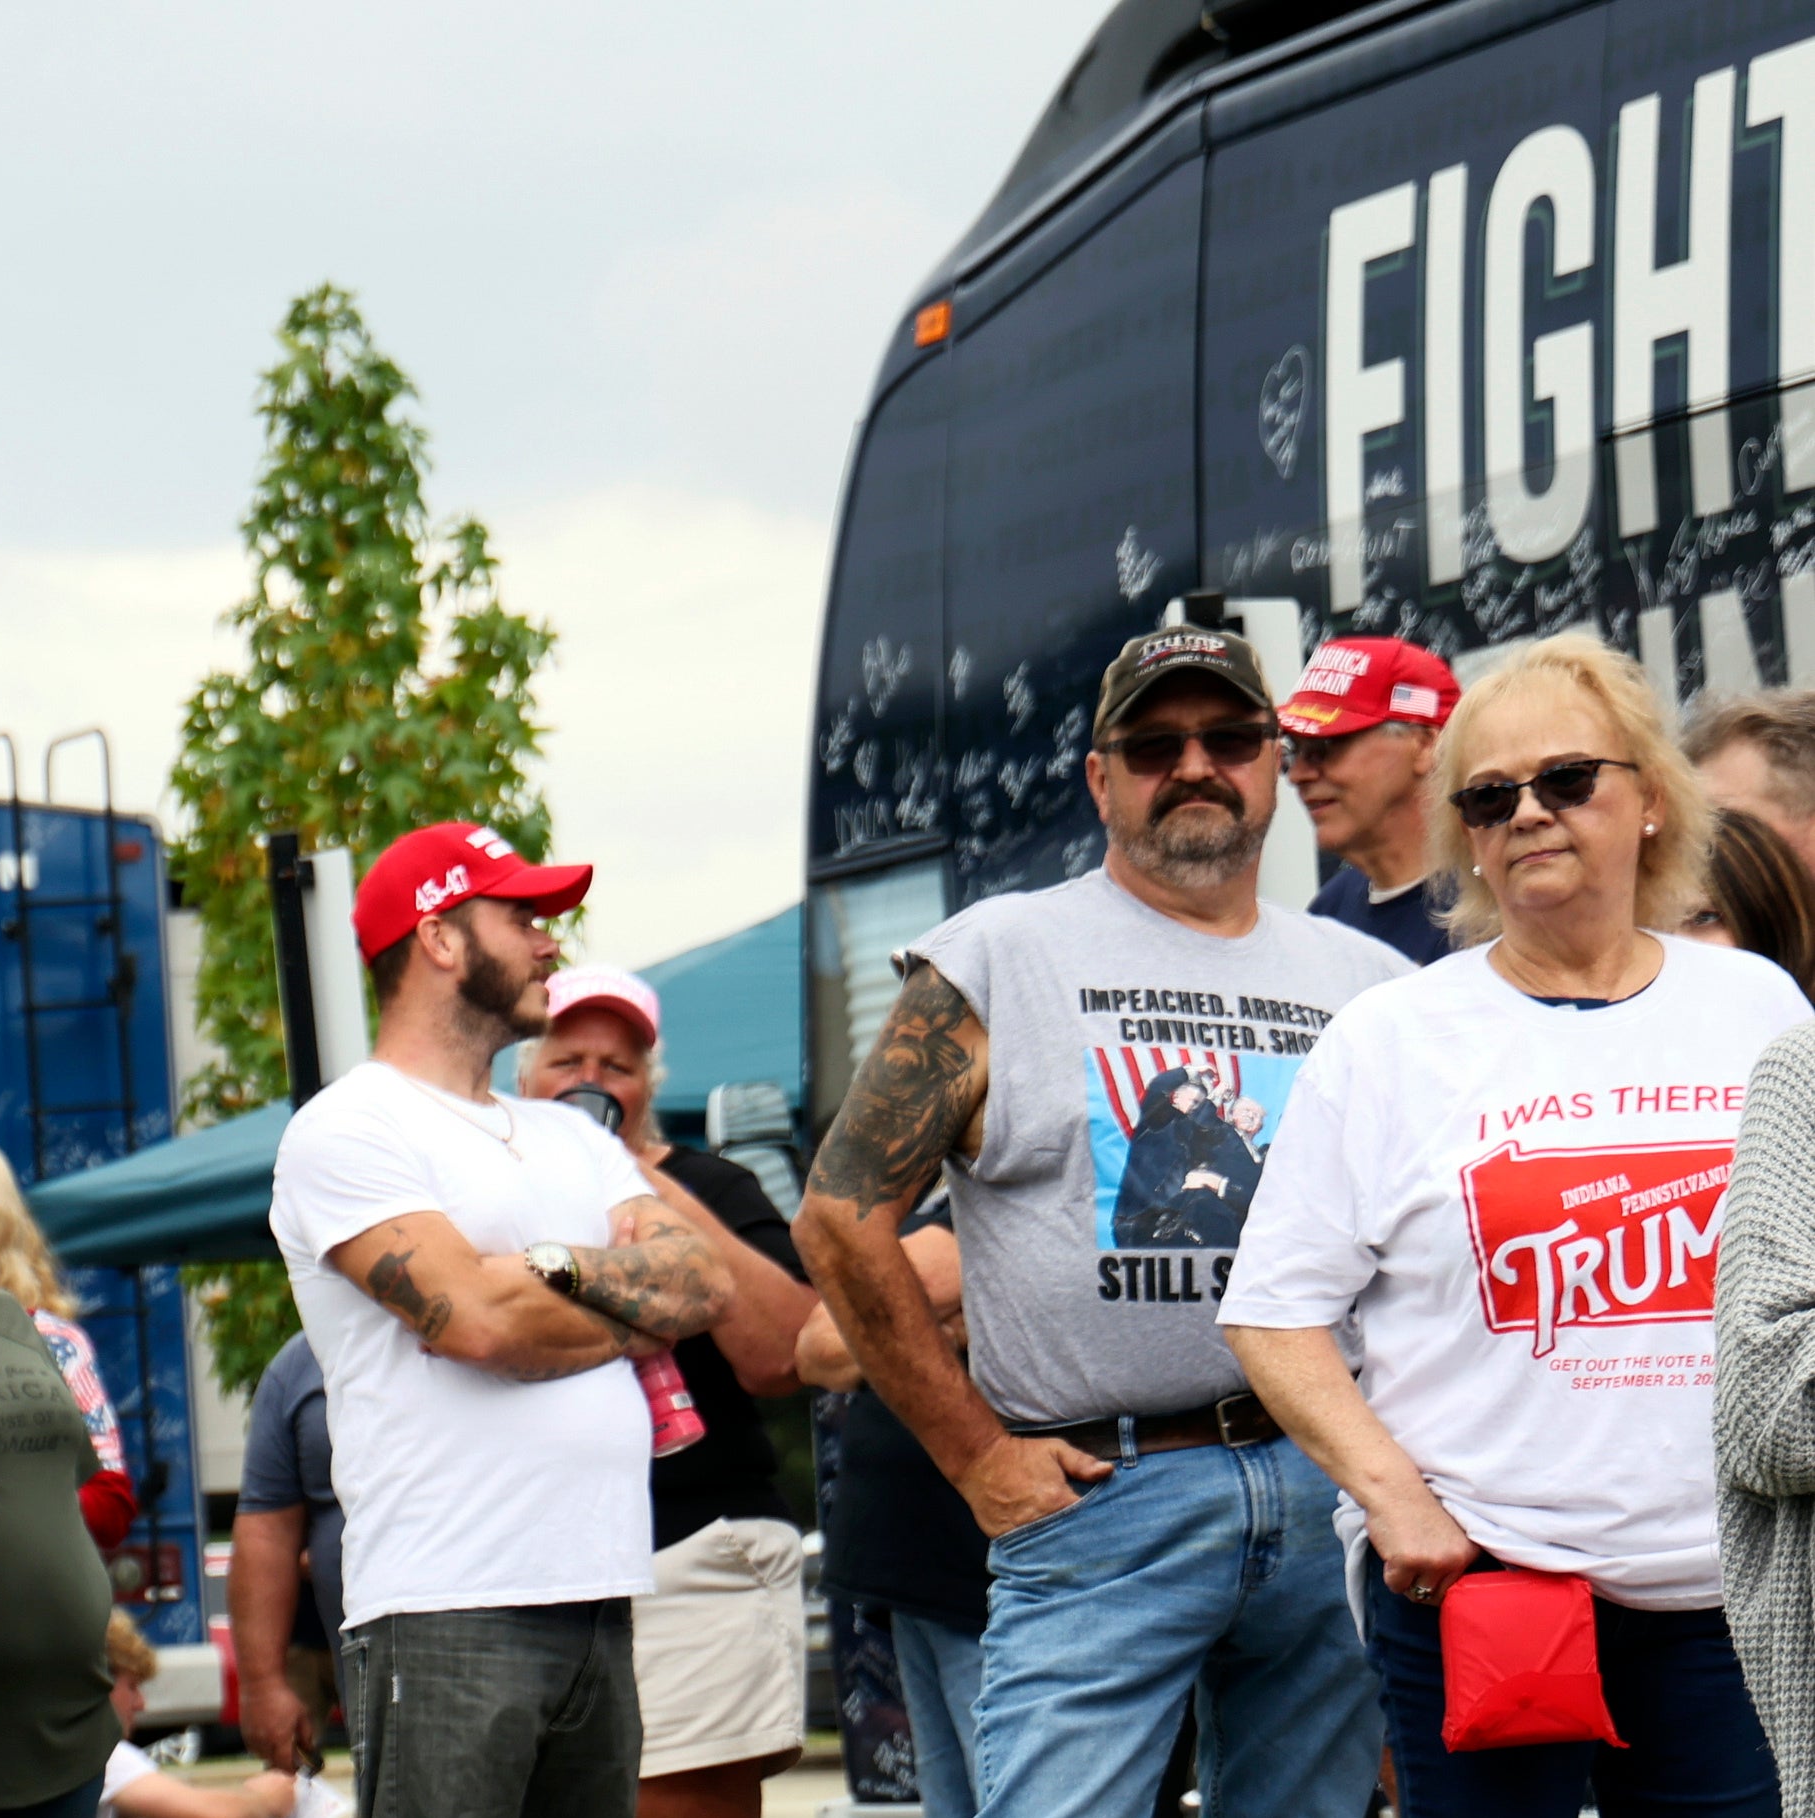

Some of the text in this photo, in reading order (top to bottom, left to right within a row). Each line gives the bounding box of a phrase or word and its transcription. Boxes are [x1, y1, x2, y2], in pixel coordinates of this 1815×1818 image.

[1079, 988, 1333, 1031] IMPEACHED. ARRESTE
[1120, 1018, 1319, 1055] CONVICTED. SHO
[1478, 1085, 1745, 1141] I WAS THERE
[1560, 1173, 1632, 1210] INDIANA
[1097, 1257, 1202, 1303] STILL
[1490, 1190, 1728, 1360] TRUM
[1549, 1359, 1582, 1373] GET
[1586, 1358, 1618, 1372] OUT
[1623, 1357, 1652, 1370] THE
[1656, 1355, 1696, 1369] VOTE
[1571, 1374, 1665, 1390] SEPTEMBER
[1668, 1374, 1688, 1387] 23,
